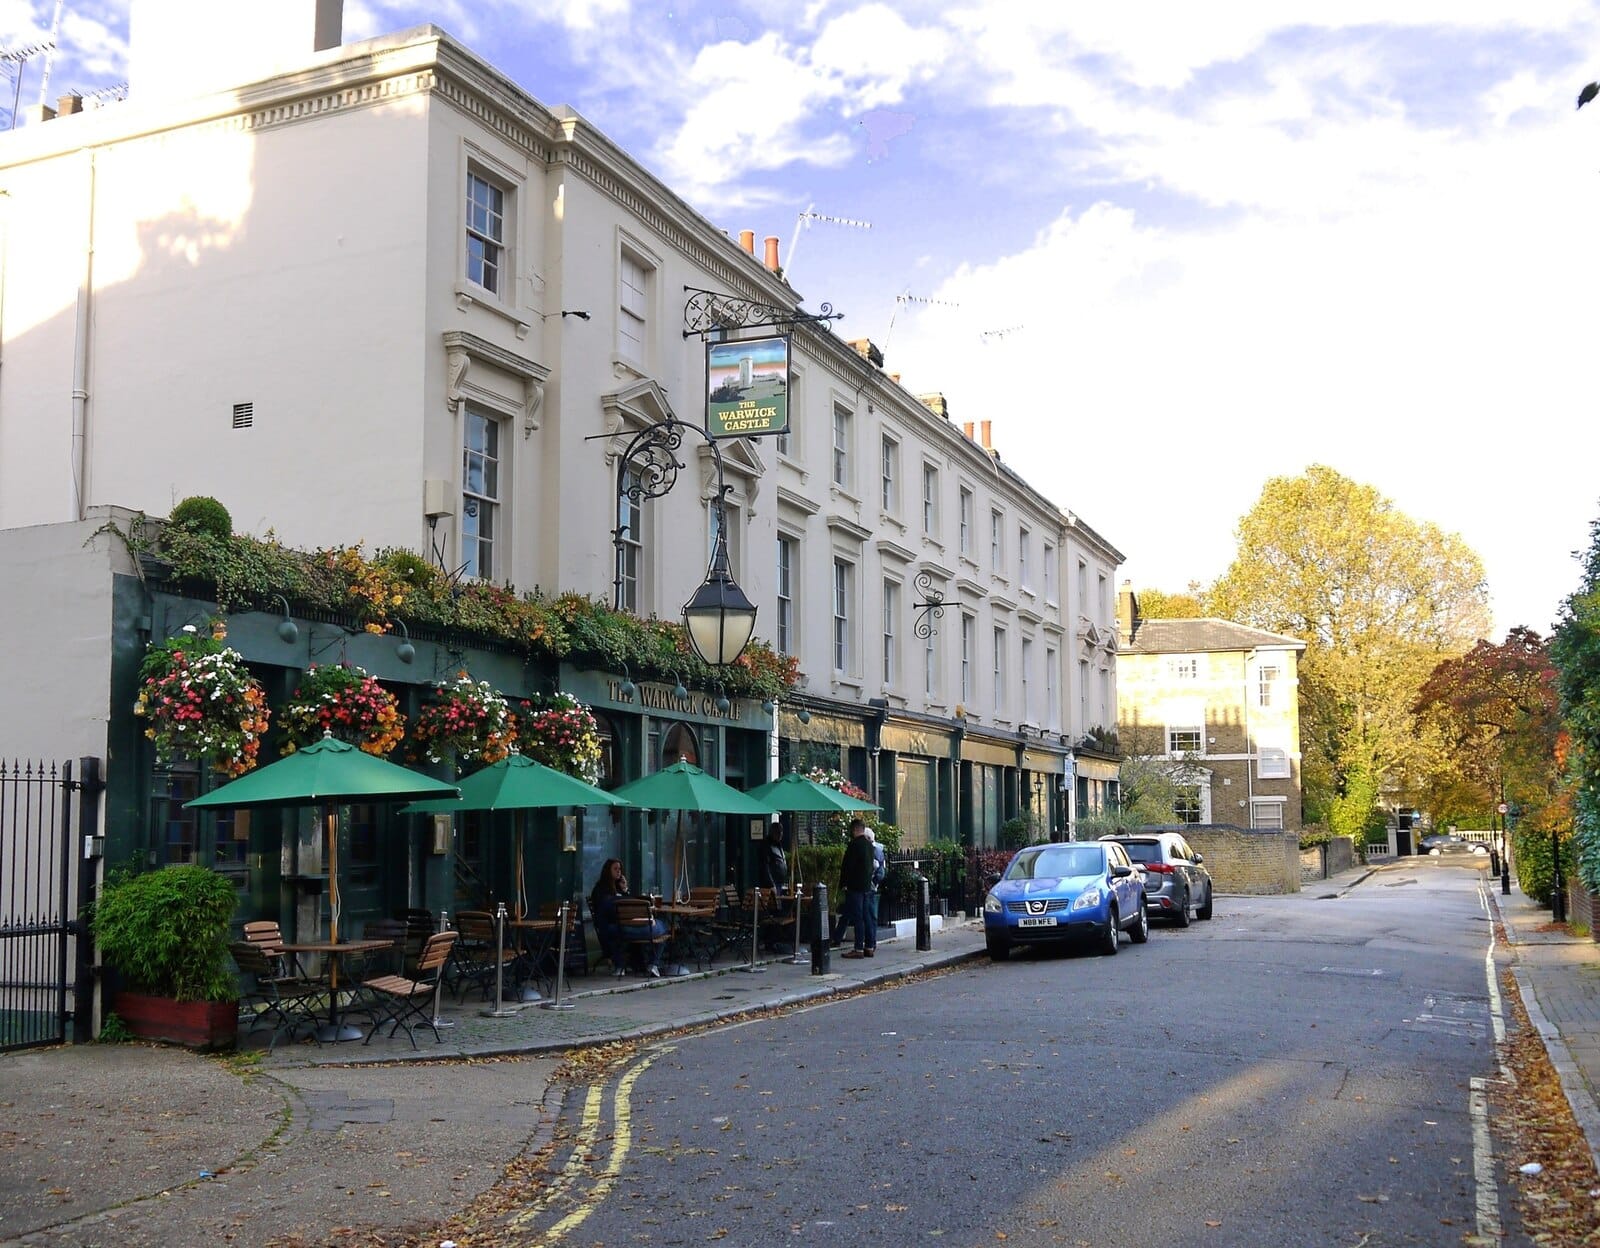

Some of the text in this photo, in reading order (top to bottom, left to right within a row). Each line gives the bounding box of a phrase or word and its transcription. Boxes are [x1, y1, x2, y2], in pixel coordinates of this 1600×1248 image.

[739, 401, 755, 409] THE
[719, 407, 777, 420] WARWICK
[724, 418, 770, 431] CASTLE
[703, 697, 743, 720] CALE
